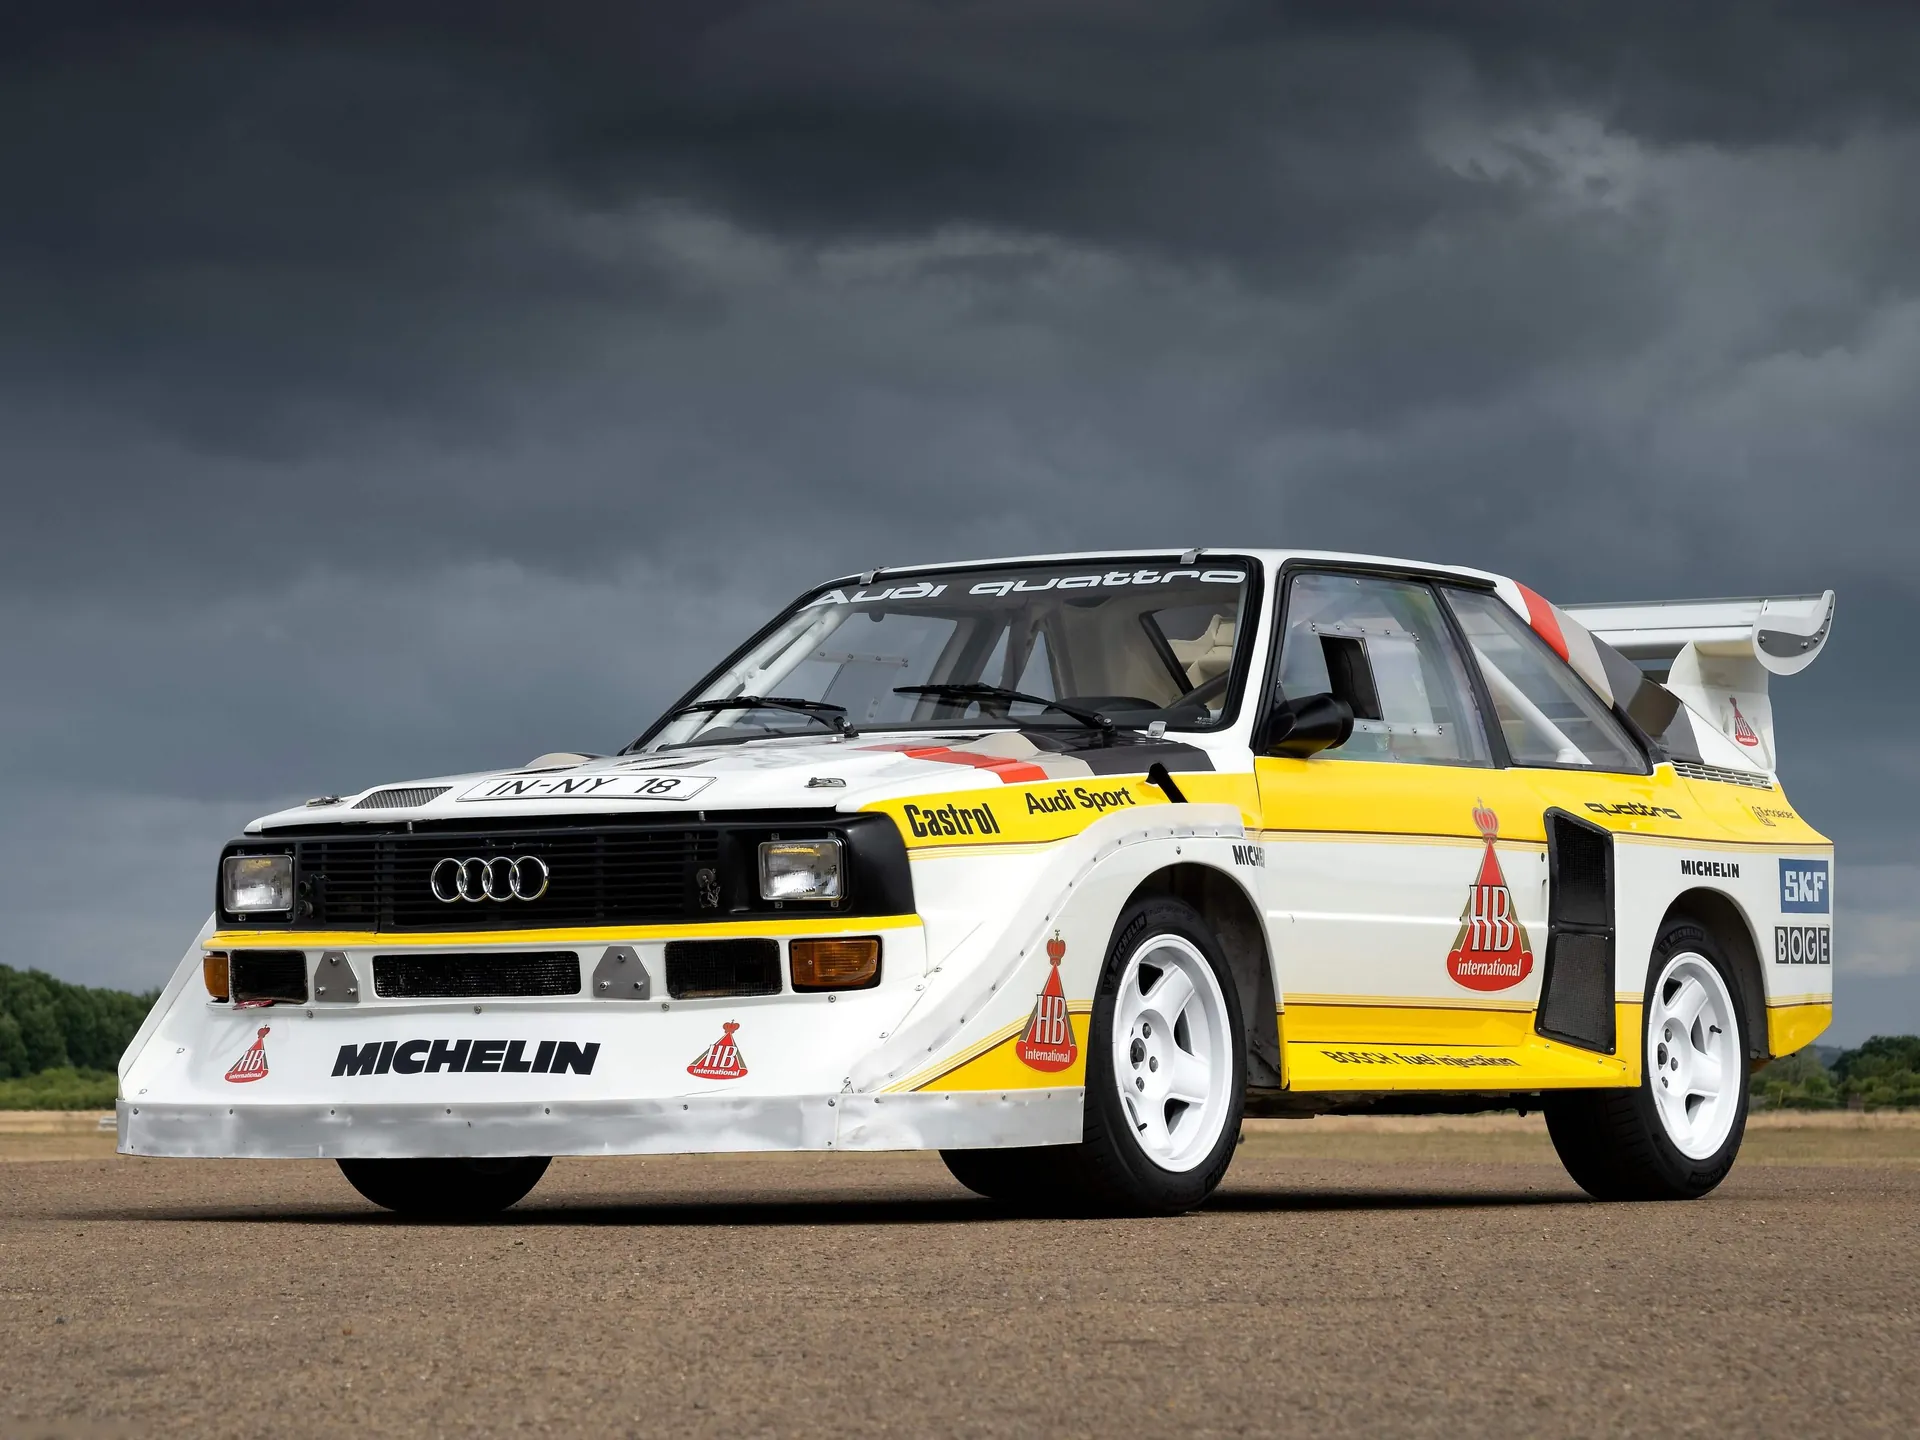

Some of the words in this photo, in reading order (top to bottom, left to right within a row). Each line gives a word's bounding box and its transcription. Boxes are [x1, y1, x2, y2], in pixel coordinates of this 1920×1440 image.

[797, 582, 948, 612] Audi
[969, 569, 1246, 597] quattro
[485, 777, 620, 797] IN-NY
[634, 777, 682, 795] 18
[1024, 791, 1076, 815] Audi
[1073, 786, 1136, 813] Sport
[1584, 801, 1683, 820] quattro
[903, 802, 1001, 838] Castrol
[1680, 859, 1741, 879] MICHELIN
[1784, 870, 1827, 903] SKF
[1469, 884, 1515, 952] HB
[1776, 927, 1830, 963] BOGE
[1457, 957, 1523, 977] international
[1034, 993, 1067, 1045] HB
[237, 1049, 266, 1072] HB
[331, 1039, 602, 1078] MICHELIN
[702, 1044, 738, 1068] HB
[1025, 1046, 1071, 1063] international
[1319, 1050, 1401, 1065] BOSCH
[1392, 1052, 1441, 1066] fuel
[1429, 1053, 1523, 1069] injection
[693, 1067, 741, 1077] international
